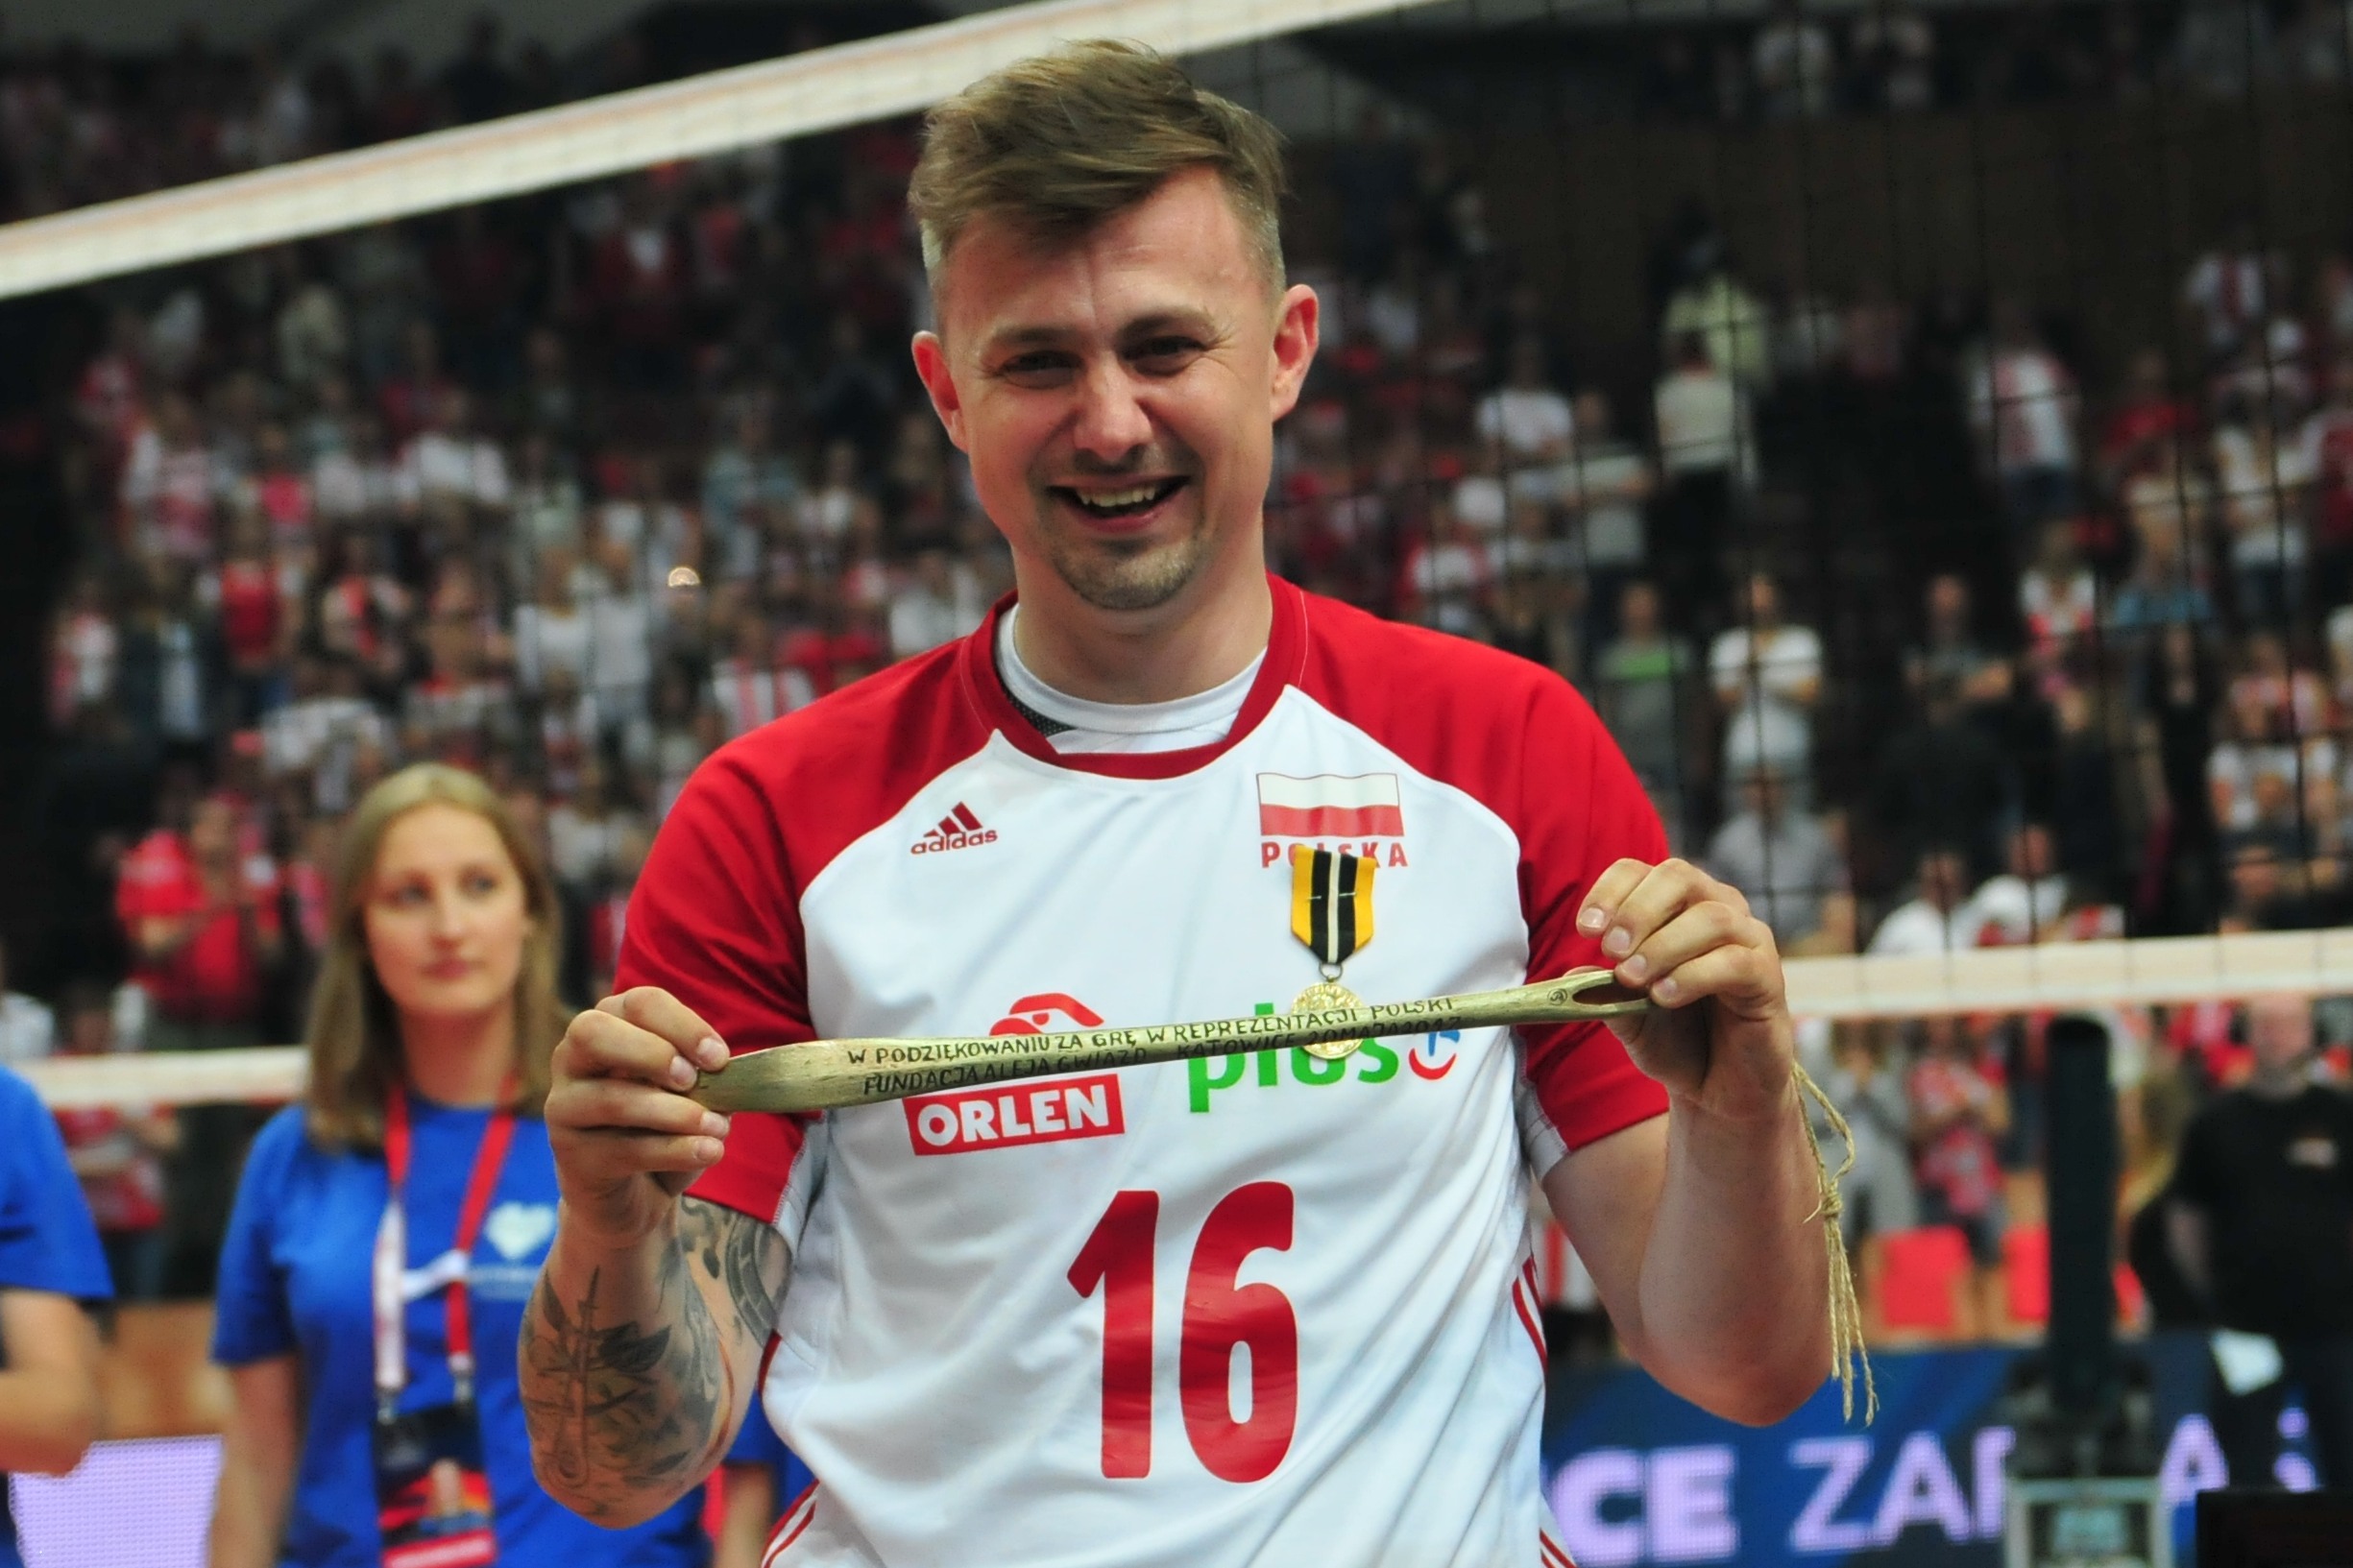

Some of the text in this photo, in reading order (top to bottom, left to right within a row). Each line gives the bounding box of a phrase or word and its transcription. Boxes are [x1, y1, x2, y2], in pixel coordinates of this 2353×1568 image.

[910, 830, 998, 855] adidas
[1261, 841, 1408, 868] PKA
[848, 1049, 867, 1064] W
[876, 1035, 1051, 1063] PODZIĘKOWANIU
[1056, 1034, 1083, 1049] ZA
[1091, 1030, 1137, 1047] GRĘ
[1147, 1027, 1166, 1043] W
[1174, 1007, 1358, 1043] REPREZENTACJI
[1370, 998, 1453, 1020] POLSKI
[863, 1067, 979, 1096] FUNDACJA
[984, 1055, 1053, 1079] ALEJA
[1056, 1047, 1147, 1073] GWIAZD
[1177, 1032, 1298, 1059] KATOWICE
[916, 1083, 1111, 1147] ORLEN
[1067, 1181, 1298, 1483] 16
[1540, 1444, 1738, 1567] CE
